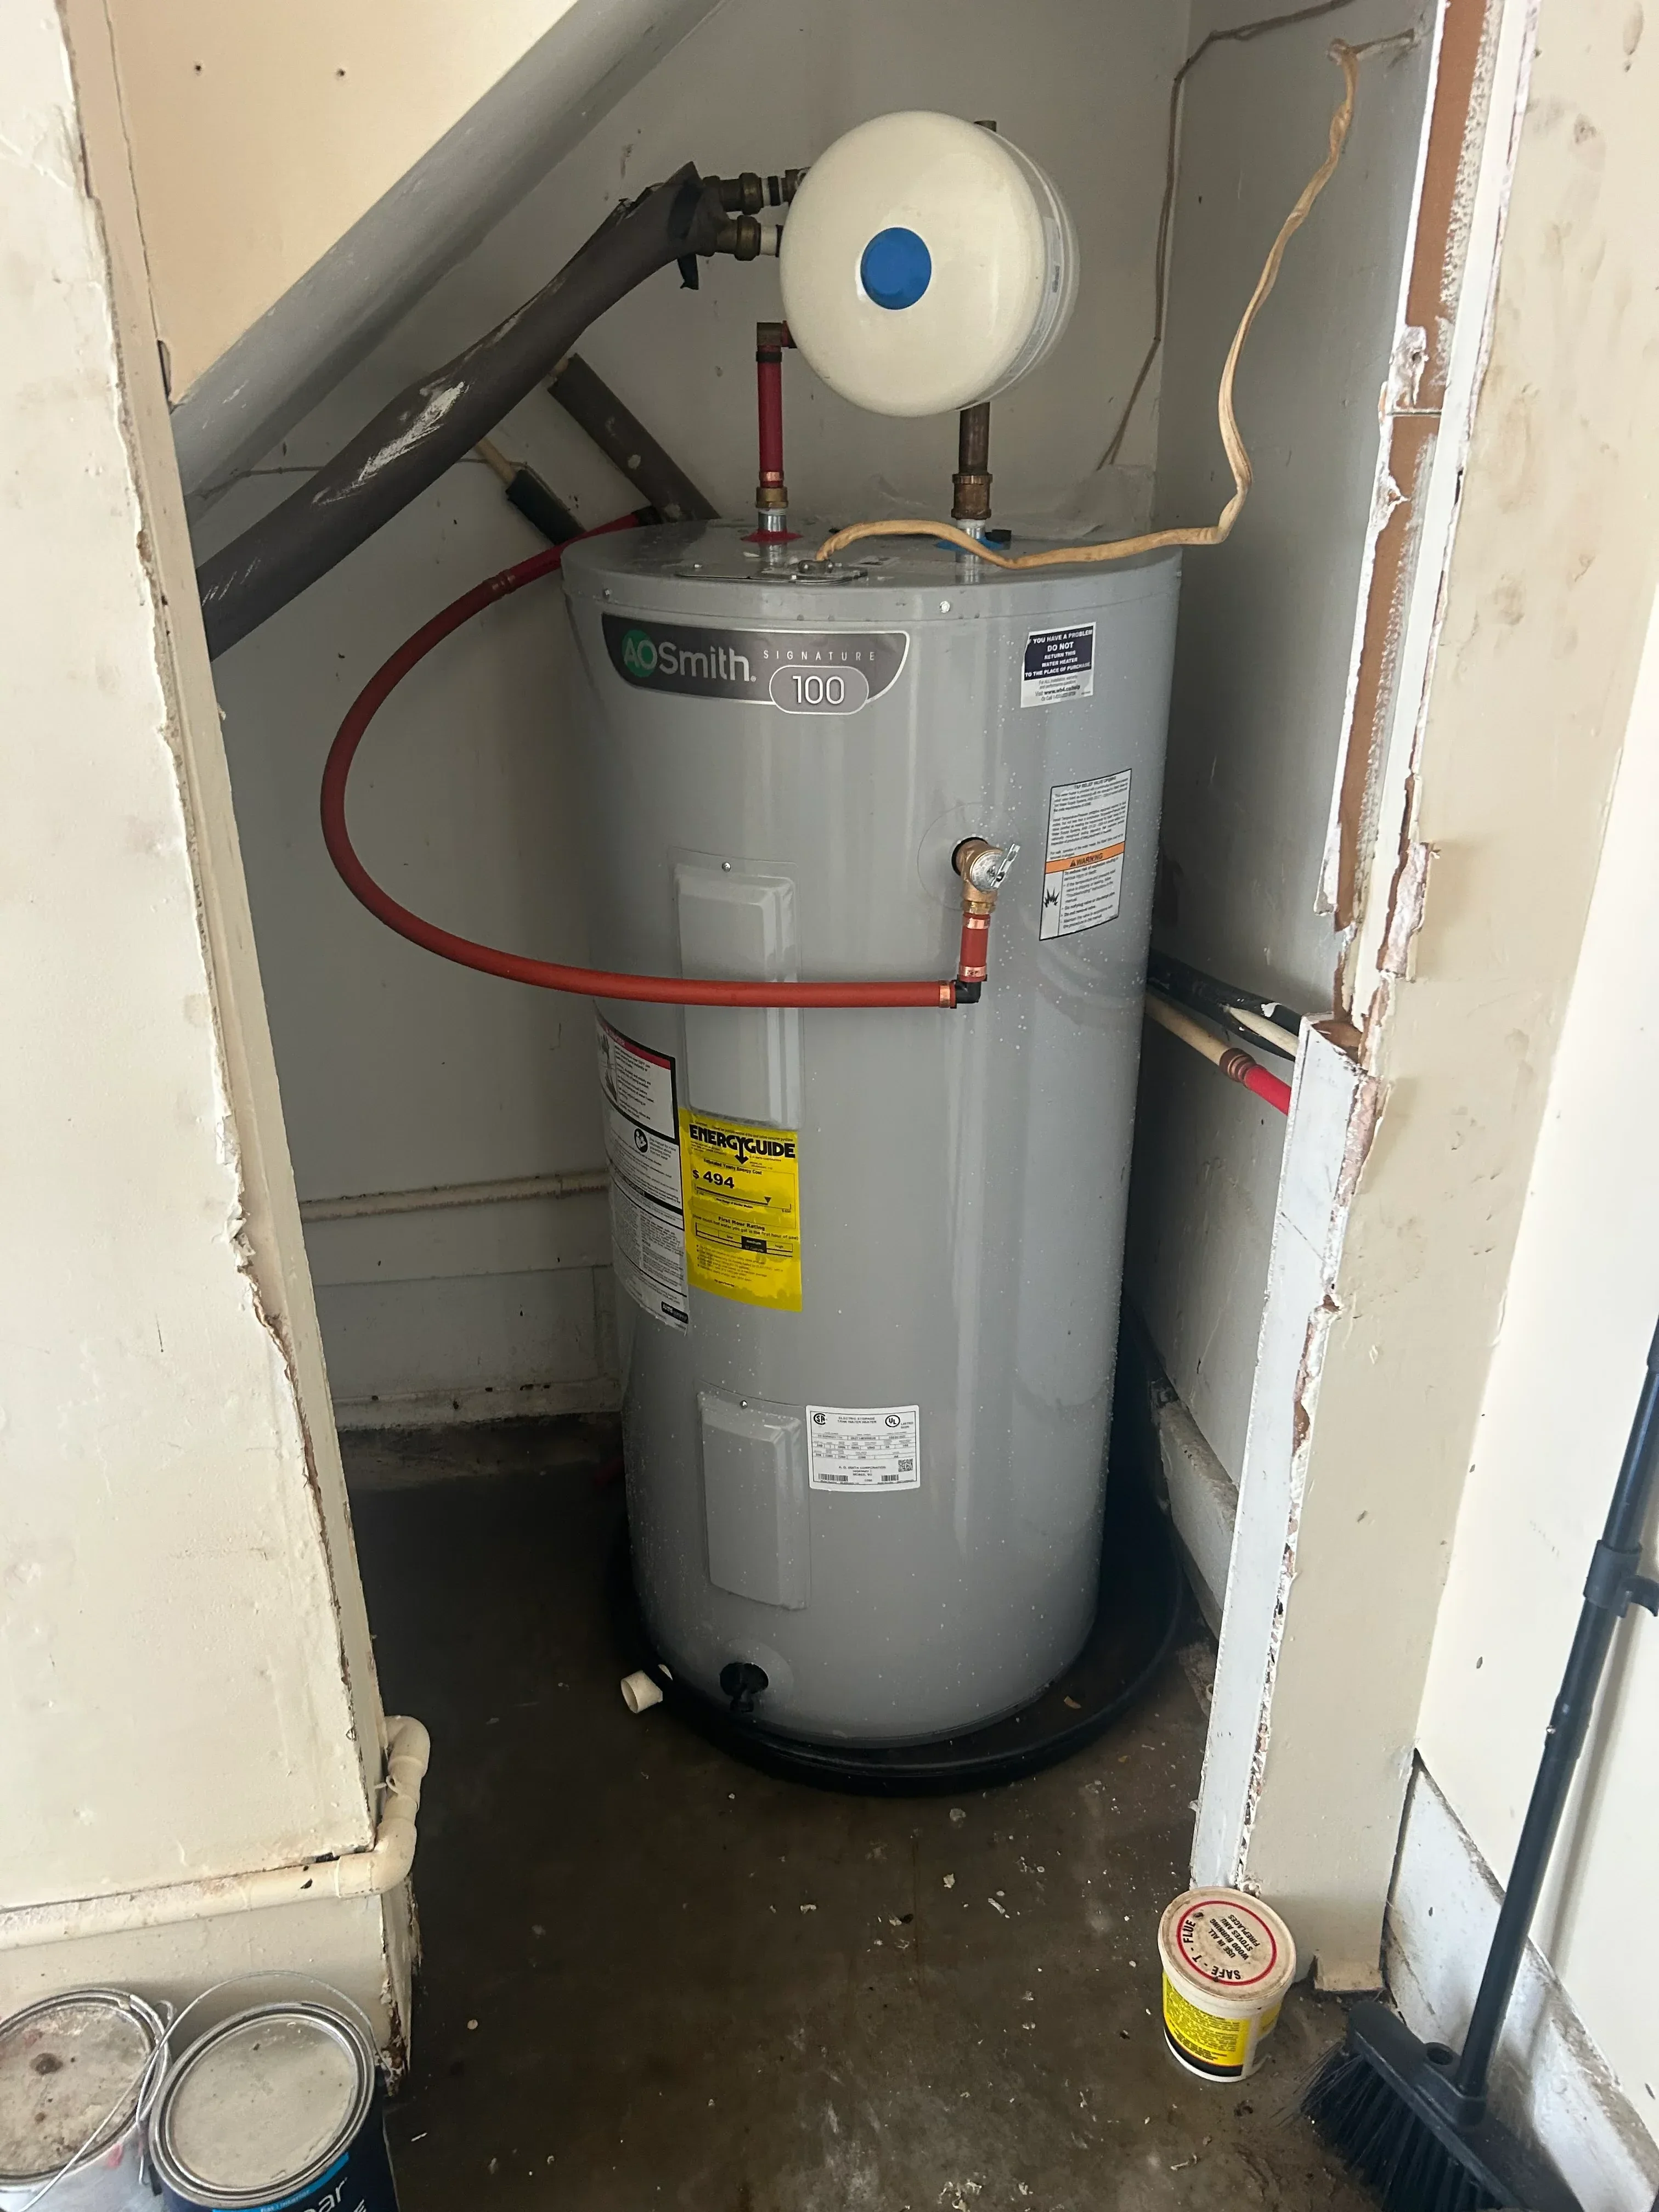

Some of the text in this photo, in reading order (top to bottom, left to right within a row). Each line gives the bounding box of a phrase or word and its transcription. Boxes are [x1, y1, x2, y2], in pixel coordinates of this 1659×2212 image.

[1068, 629, 1093, 639] PROBLEM
[1059, 641, 1074, 650] NOT
[763, 649, 876, 662] SIGNATURE
[1059, 657, 1078, 665] HEATER
[792, 675, 845, 705] 100
[1076, 853, 1103, 866] WARNING
[689, 1124, 796, 1159] ENERGYGUIDE
[703, 1170, 735, 1189] 494
[747, 1222, 765, 1232] Rating
[1182, 1920, 1196, 1943] FLUE
[1208, 1928, 1220, 1939] ALL
[1228, 1914, 1261, 1947] FIREPLACES
[1210, 1918, 1249, 1960] WOOD BURNING
[1231, 1930, 1253, 1951] STOVES
[1223, 1946, 1236, 1959] USE
[1211, 1965, 1241, 1980] SAFE
